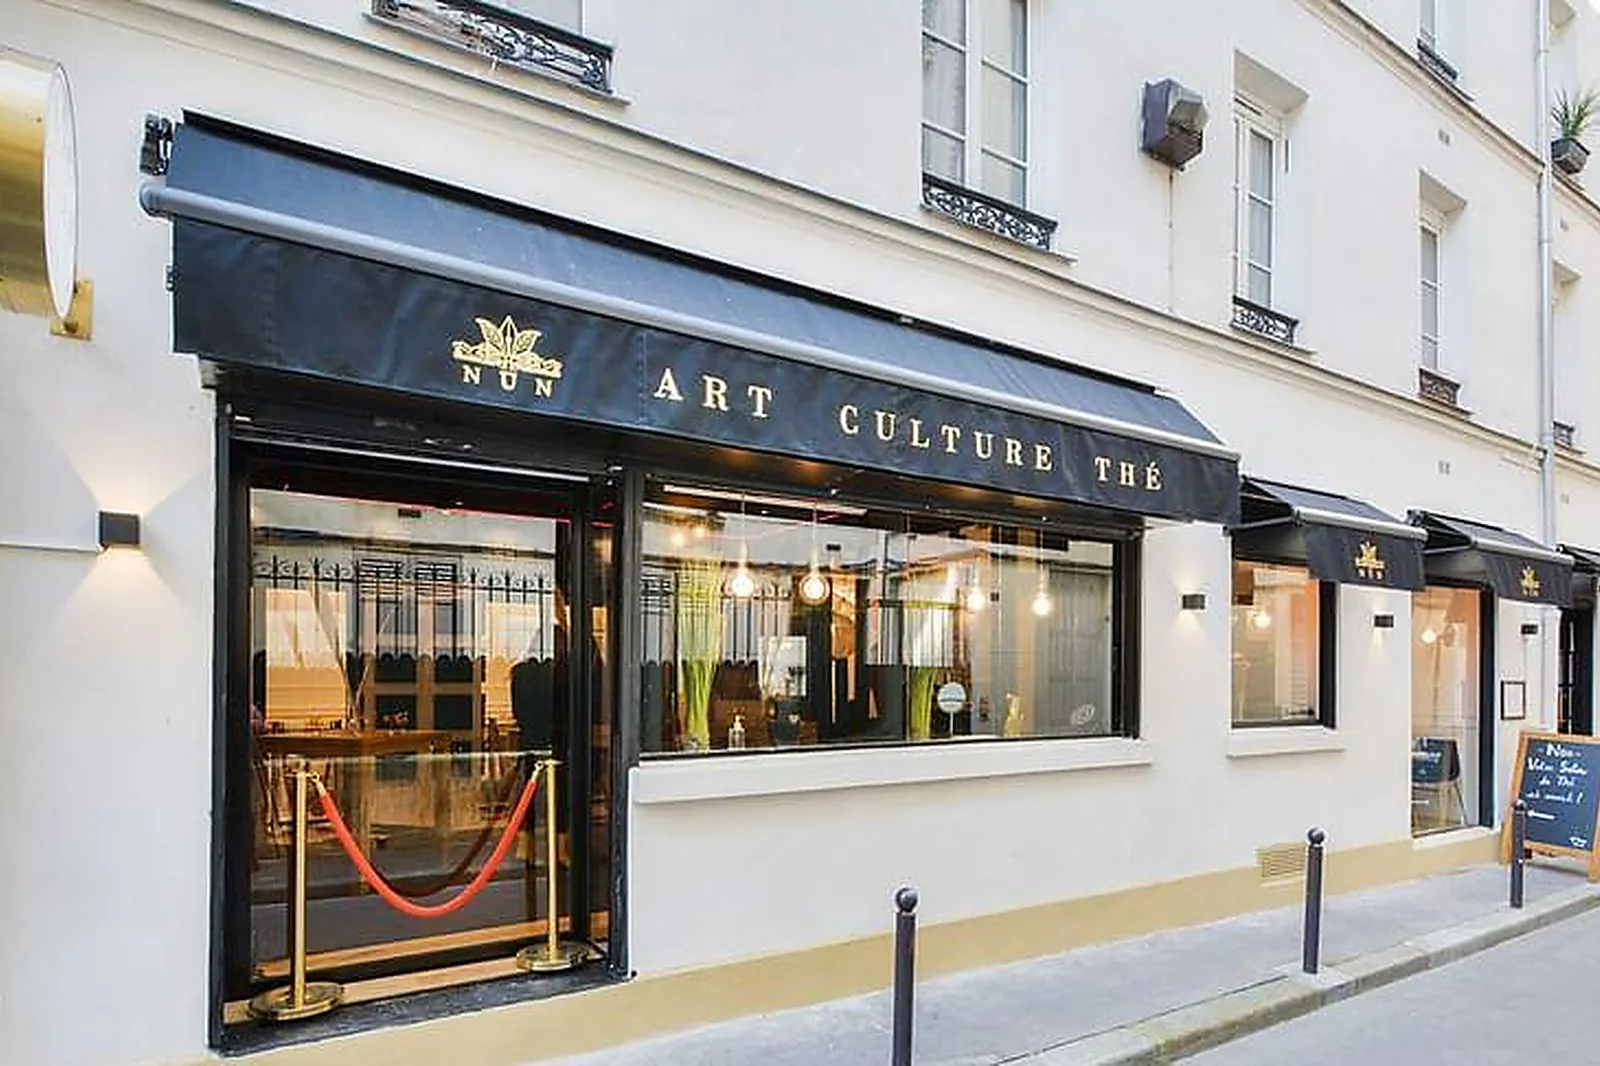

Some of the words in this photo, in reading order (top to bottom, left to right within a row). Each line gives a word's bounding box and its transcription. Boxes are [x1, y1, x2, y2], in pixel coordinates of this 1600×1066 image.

[463, 365, 553, 398] NUN
[653, 367, 773, 419] ART
[839, 404, 1053, 472] CULTURE
[1094, 456, 1163, 491] THÉ
